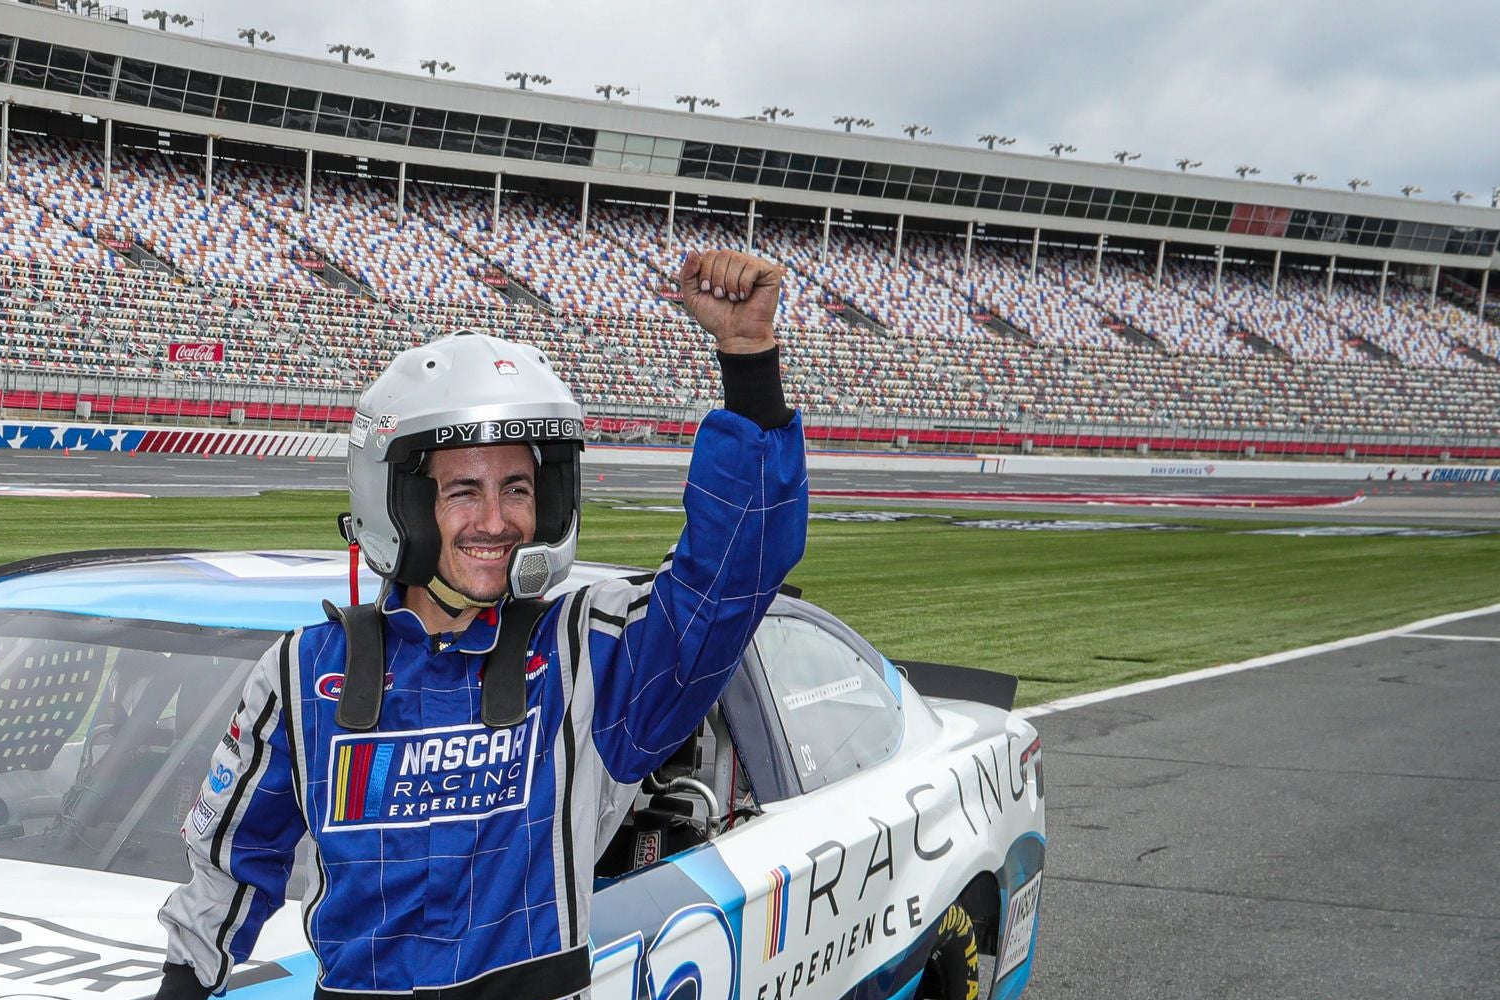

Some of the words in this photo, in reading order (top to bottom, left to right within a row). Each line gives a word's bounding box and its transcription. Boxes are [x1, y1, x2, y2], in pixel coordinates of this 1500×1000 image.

[1431, 468, 1489, 481] CHARLOTTE
[399, 723, 528, 776] NASCAR
[393, 762, 522, 798] RACING
[388, 785, 518, 817] EXPERIENCE
[644, 835, 656, 866] G-FO
[804, 732, 1026, 936] RACING
